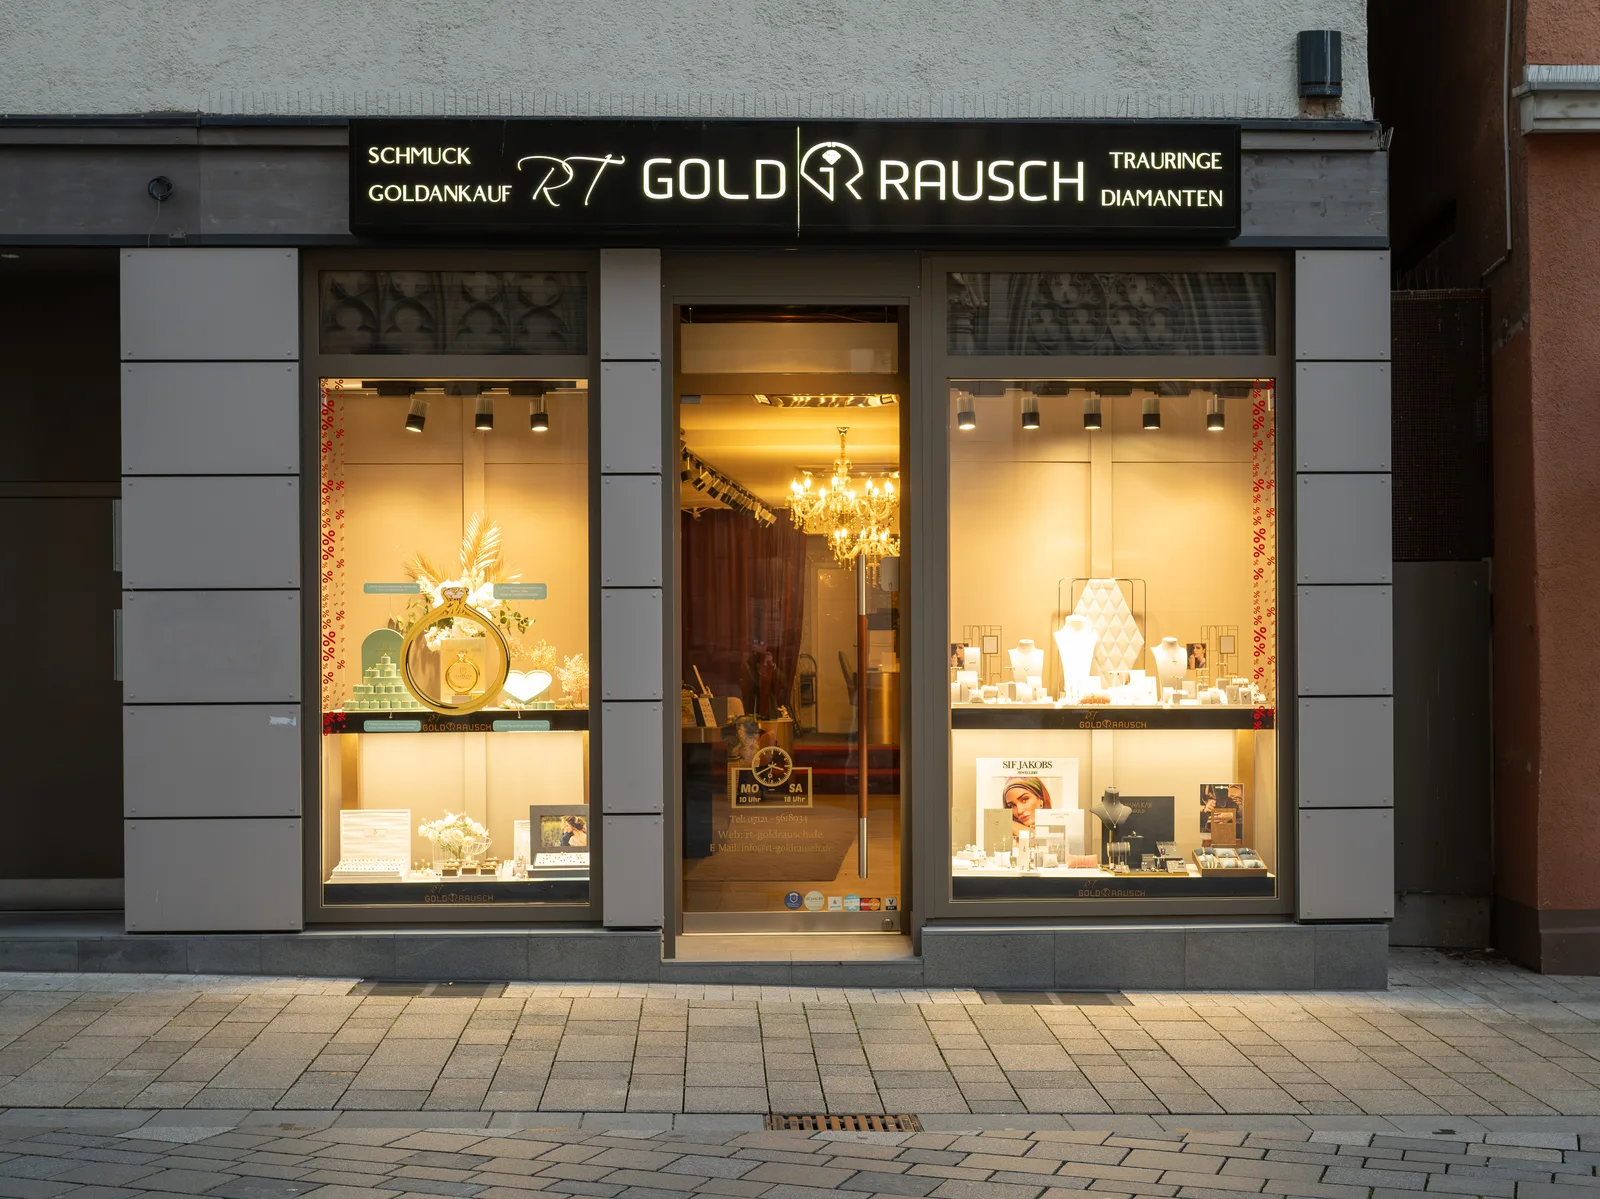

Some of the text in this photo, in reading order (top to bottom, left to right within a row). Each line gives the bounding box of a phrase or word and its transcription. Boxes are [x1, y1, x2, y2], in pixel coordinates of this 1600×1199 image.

[368, 146, 472, 165] SCHMUCK
[1108, 150, 1223, 170] TRAURINGE
[517, 153, 626, 207] RT
[642, 157, 787, 201] GOLD
[879, 158, 1085, 202] RAUSCH
[368, 184, 513, 203] GOLDANKAUF
[1100, 188, 1223, 208] DIAMANTEN
[422, 724, 446, 732] GOLD
[456, 723, 492, 731] RAUSCH
[1079, 721, 1147, 729] GOLD RAUSCH
[1002, 760, 1053, 771] SIF JAKOBS
[740, 783, 760, 794] MO
[788, 783, 803, 793] SA
[792, 795, 806, 803] Uhr
[729, 814, 746, 824] Tel:
[747, 815, 768, 825] 07121
[717, 829, 823, 841] Web: rt-goldrausch.de
